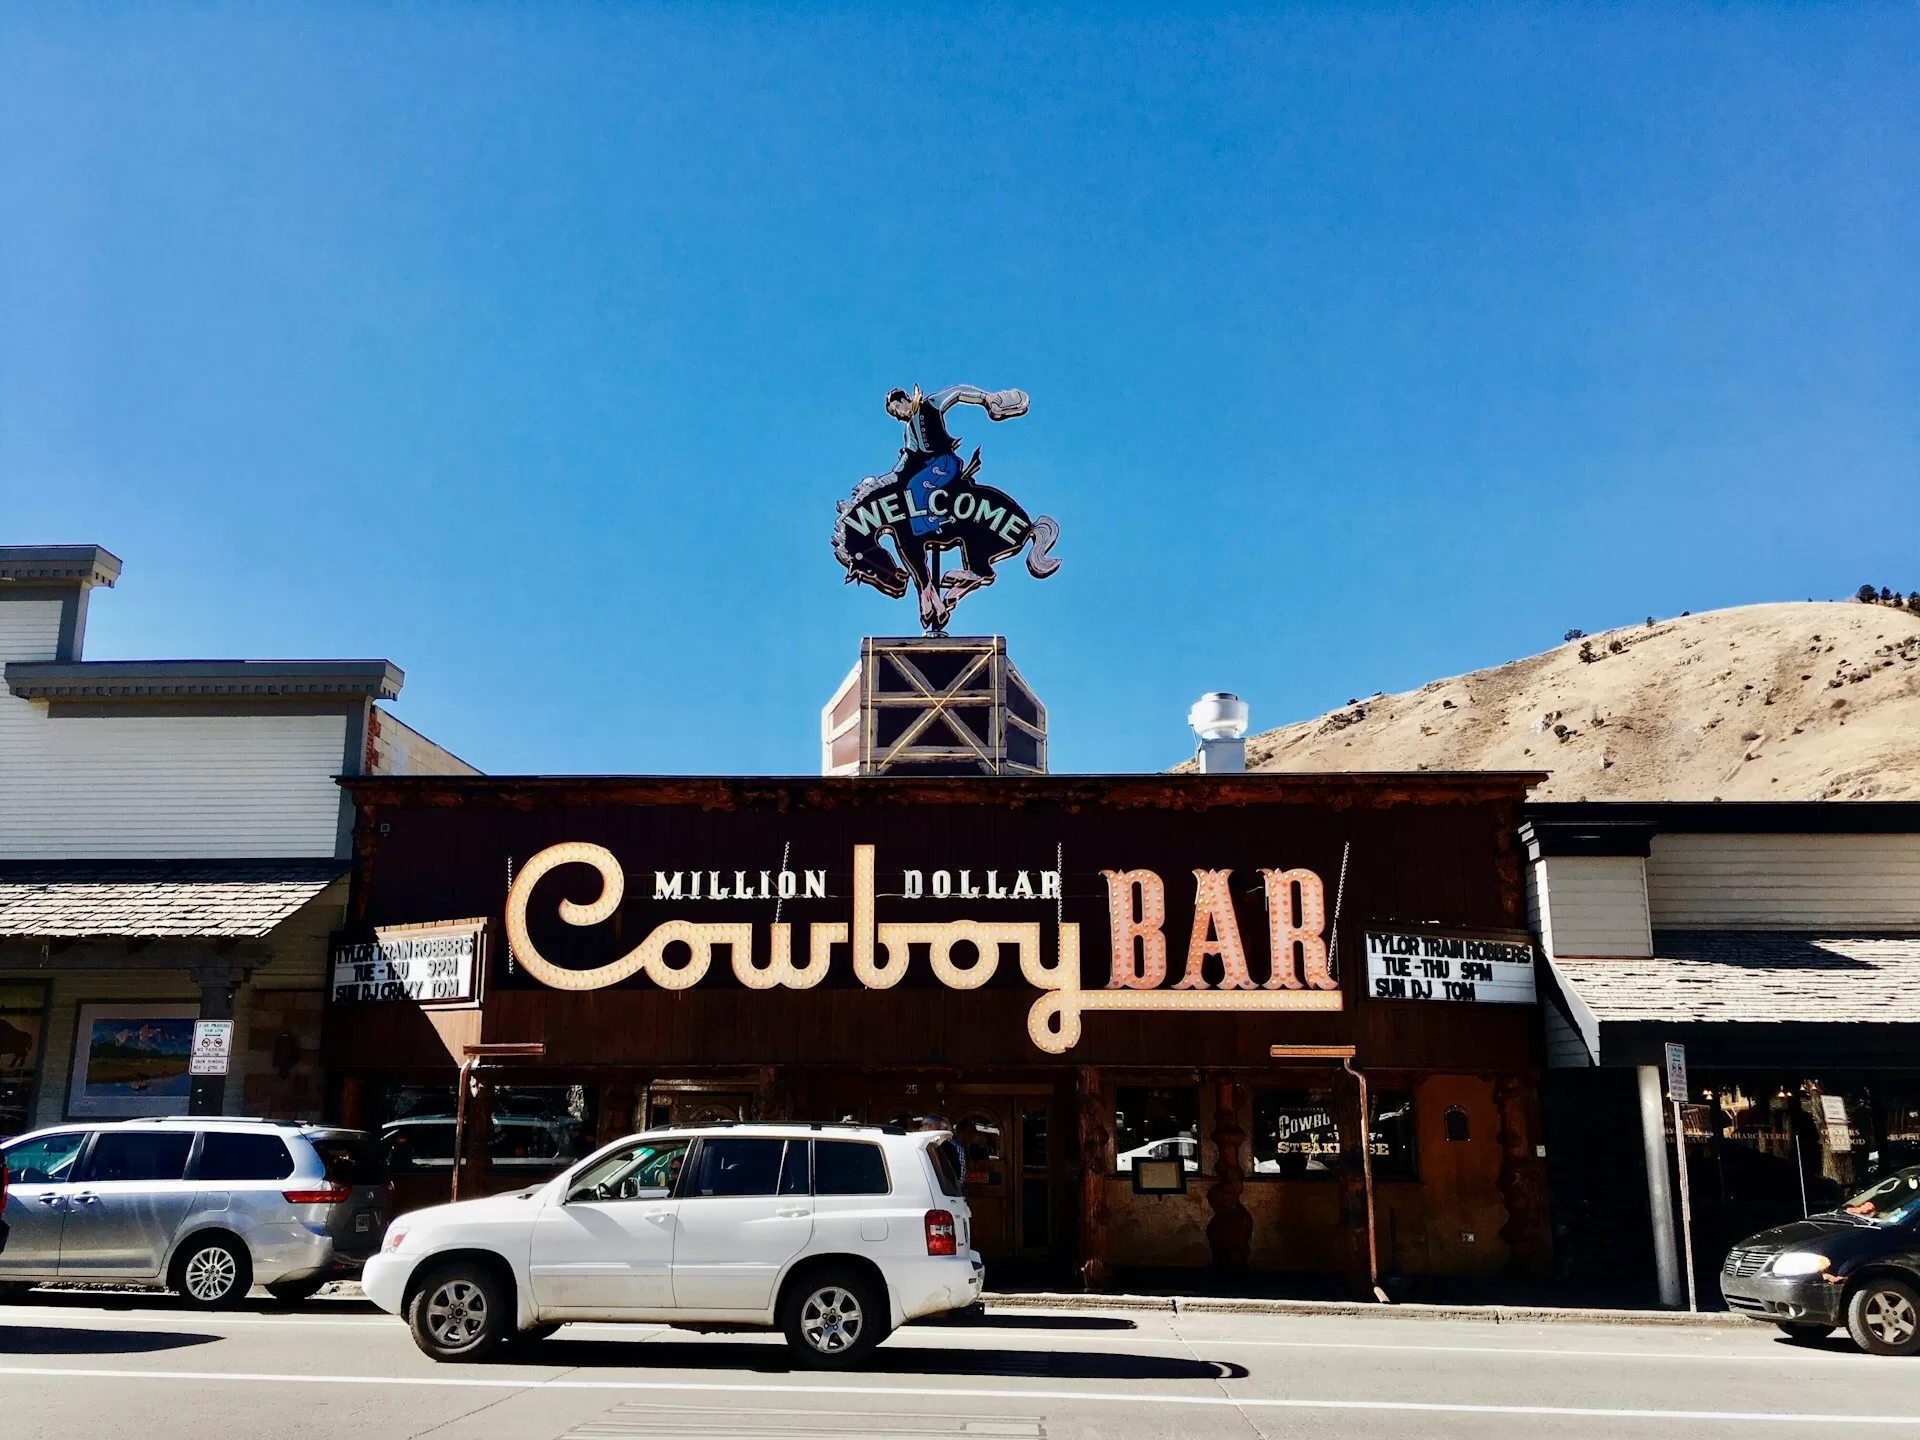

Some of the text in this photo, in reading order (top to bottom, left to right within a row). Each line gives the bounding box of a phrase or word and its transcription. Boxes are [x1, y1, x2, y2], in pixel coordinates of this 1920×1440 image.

[843, 489, 1028, 545] WELCOME
[653, 869, 1061, 900] MILLION DOLLAR
[377, 939, 412, 962] TRAIN
[414, 937, 473, 958] ROBBERS
[505, 842, 1339, 1054] Cowboy BAR
[1368, 933, 1531, 964] TYLOR TRAIN ROBBERS
[427, 958, 458, 978] 9PM
[1383, 957, 1411, 976] TUE
[1460, 962, 1493, 981] 9PM
[430, 979, 459, 998] TOM
[1376, 978, 1476, 1001] SUN DJ TOM
